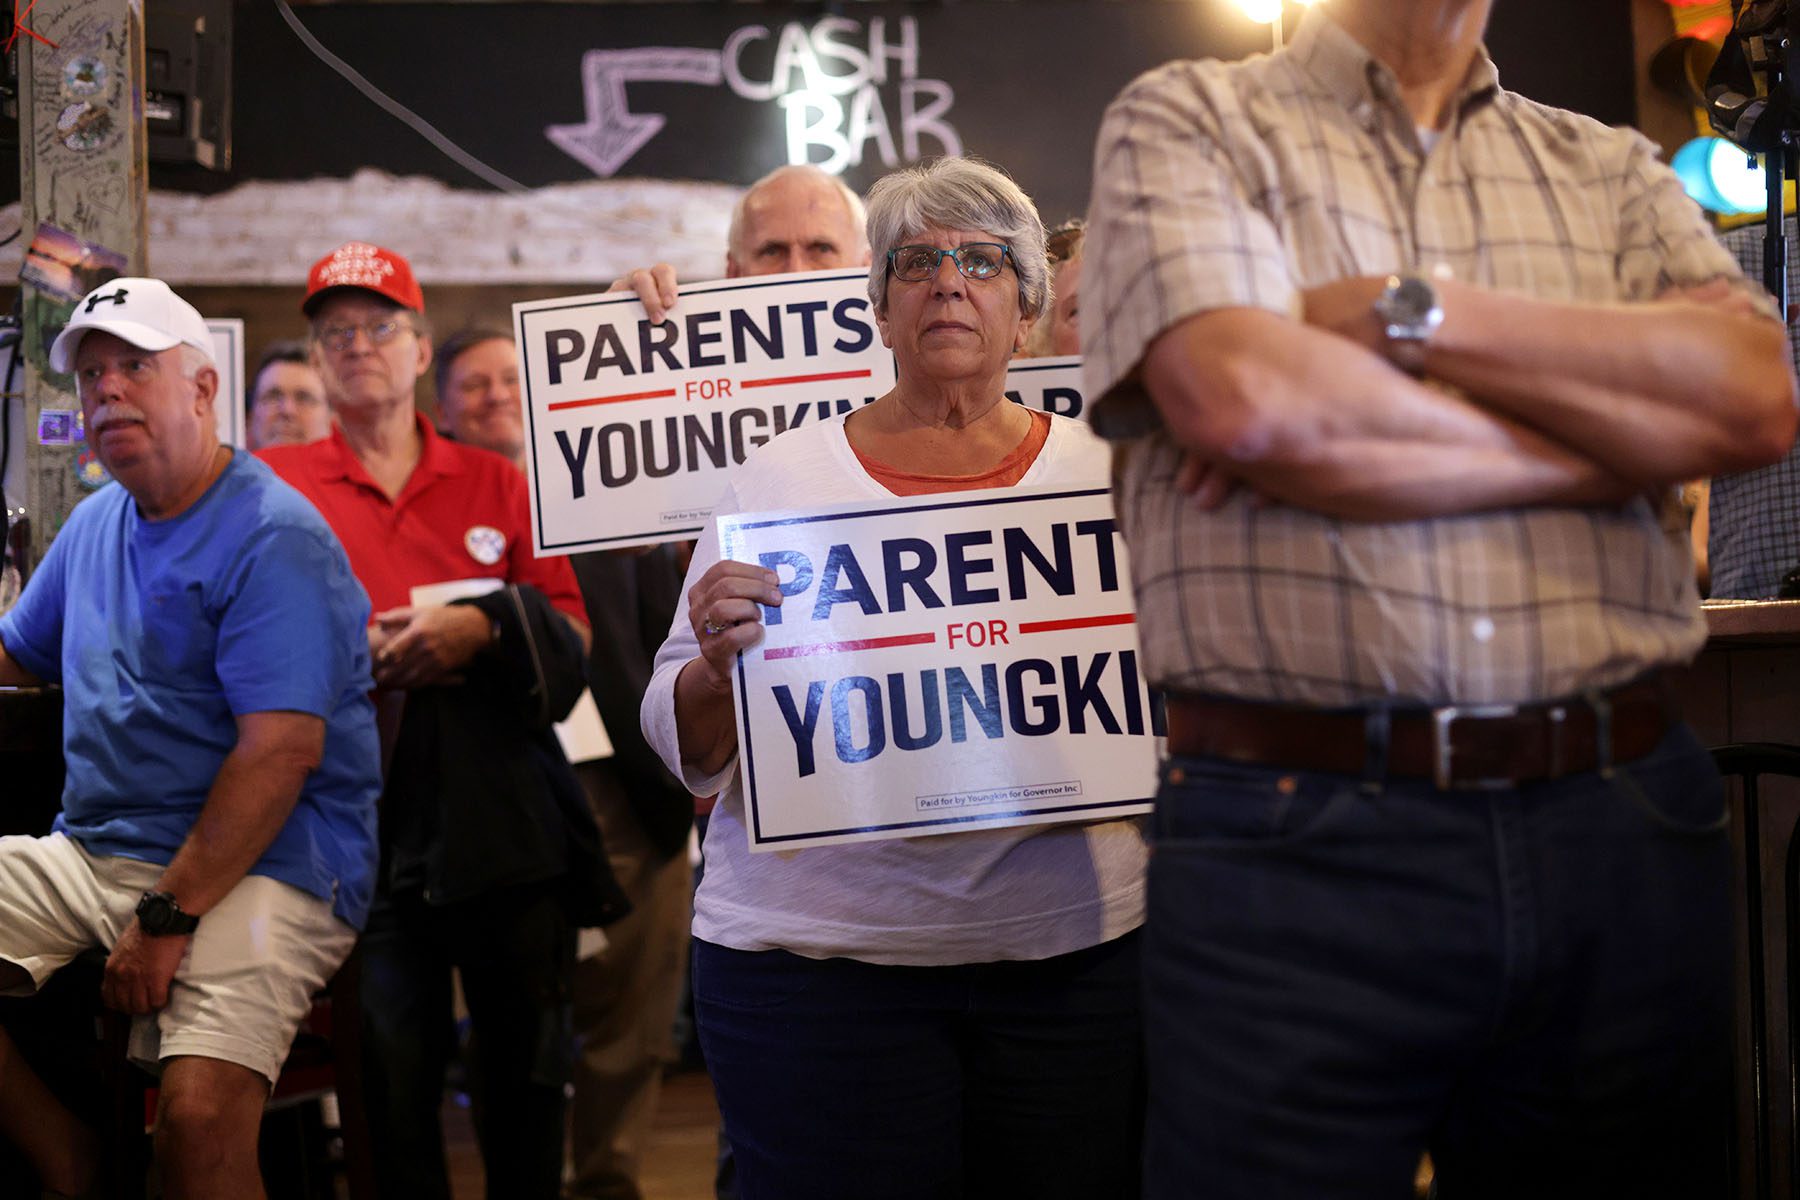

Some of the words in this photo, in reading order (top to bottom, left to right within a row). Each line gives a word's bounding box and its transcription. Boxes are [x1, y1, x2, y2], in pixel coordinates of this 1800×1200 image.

[722, 14, 918, 100] CASH
[777, 78, 963, 176] BAR
[545, 298, 874, 385] PARENTS
[685, 378, 732, 401] FOR
[758, 518, 1121, 626] PARENT
[947, 619, 1010, 650] FOR
[771, 649, 1168, 778] YOUNGKI
[920, 798, 939, 807] Paid
[941, 797, 953, 805] for
[955, 796, 966, 806] by
[967, 792, 1008, 803] Youngkin
[1010, 790, 1021, 798] for
[1023, 787, 1063, 797] Governor
[1065, 785, 1078, 793] Inc
